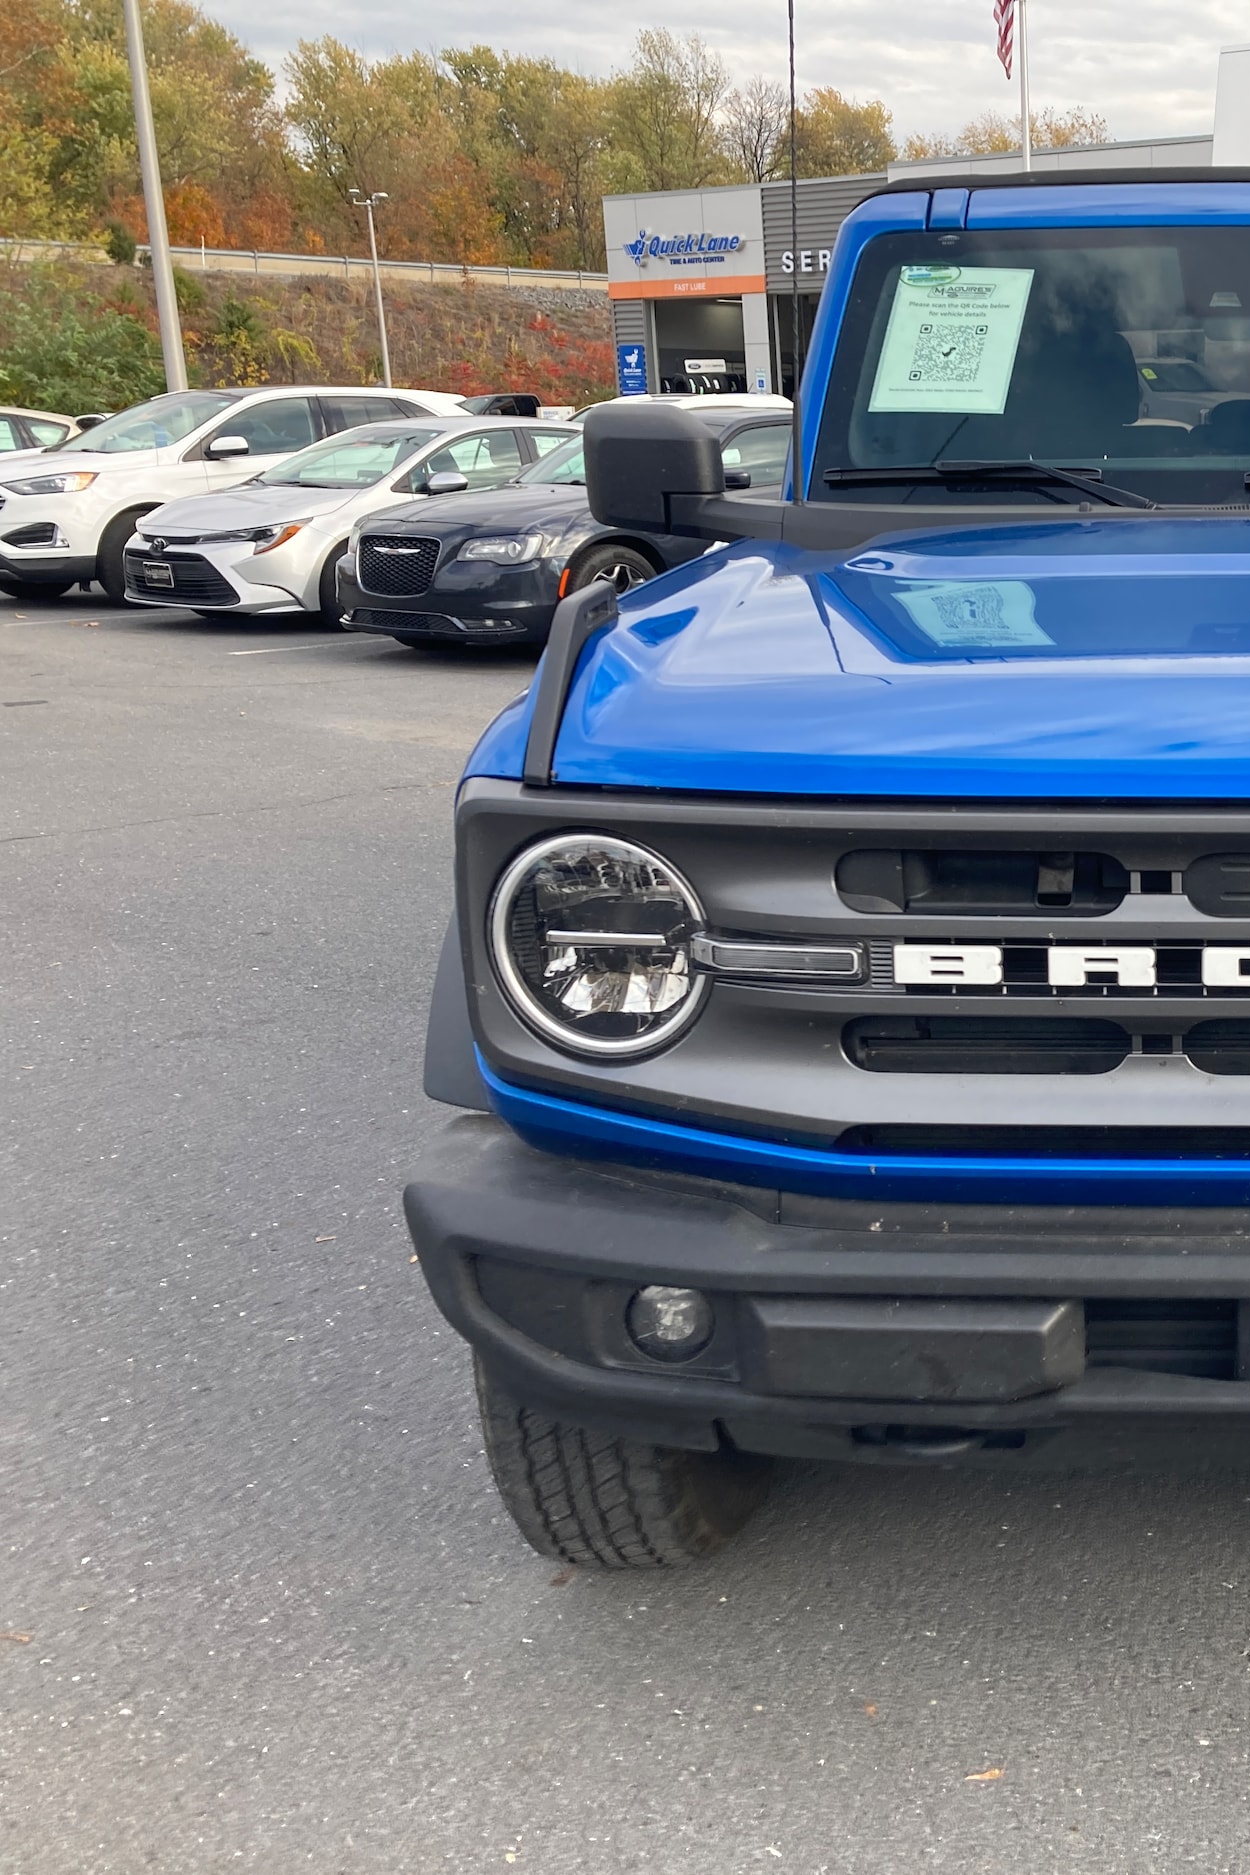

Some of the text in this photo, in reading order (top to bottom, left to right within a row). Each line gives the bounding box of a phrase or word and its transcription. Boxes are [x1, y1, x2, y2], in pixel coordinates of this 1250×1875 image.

[648, 233, 740, 257] Quick Lane
[782, 250, 831, 273] SER
[673, 282, 706, 292] FAST LUBE
